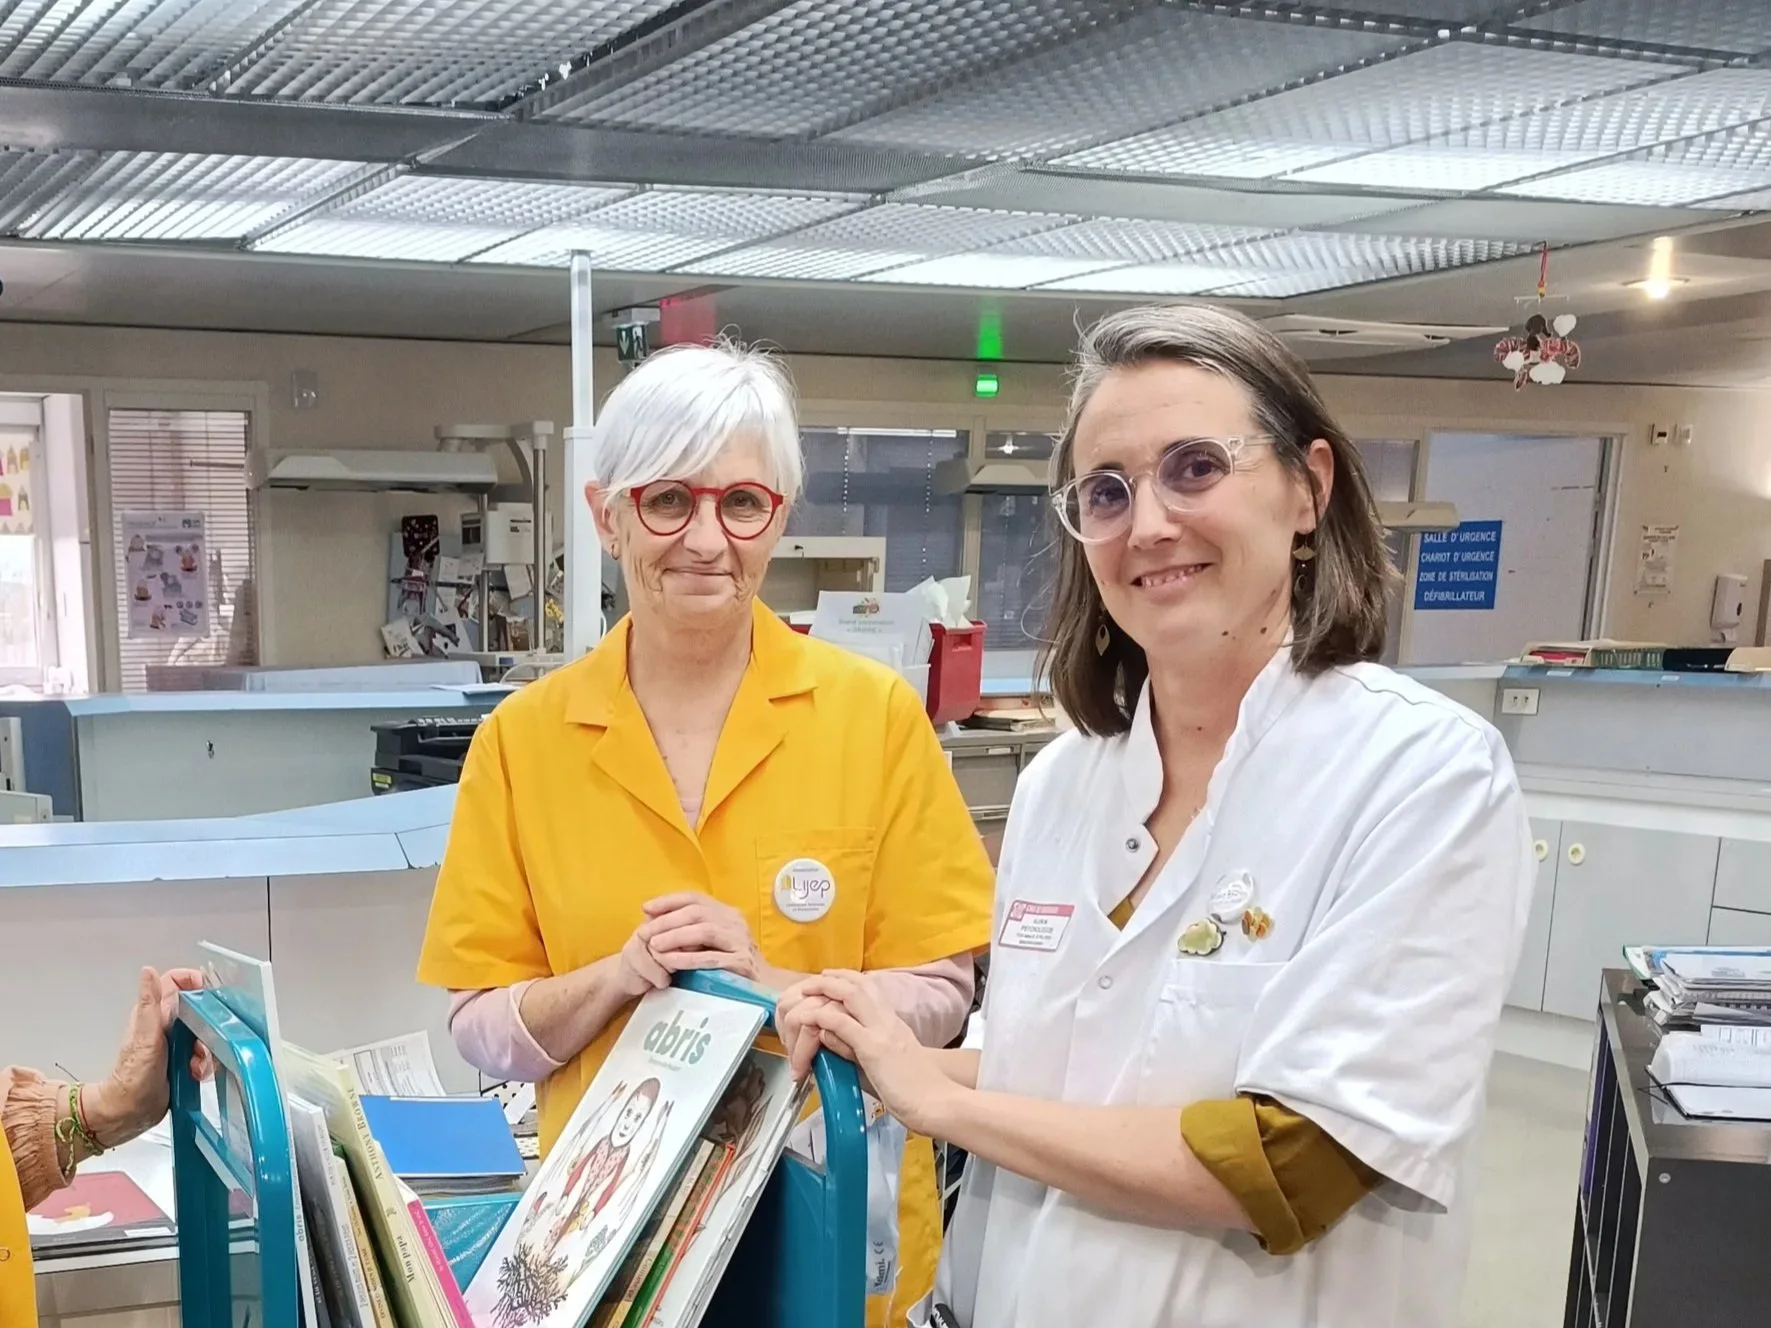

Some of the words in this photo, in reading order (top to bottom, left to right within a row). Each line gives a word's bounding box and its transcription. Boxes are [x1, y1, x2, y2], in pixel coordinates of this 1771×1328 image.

[1423, 532, 1447, 543] SALLE
[1421, 551, 1450, 563] CHARIOT
[1419, 571, 1435, 582] ZONE
[1438, 571, 1447, 581] DE
[1424, 589, 1485, 602] DÉFIBRILLATEUR
[643, 1009, 712, 1065] abris
[294, 1213, 305, 1243] abris
[397, 1235, 412, 1262] papa
[404, 1262, 416, 1284] Mon
